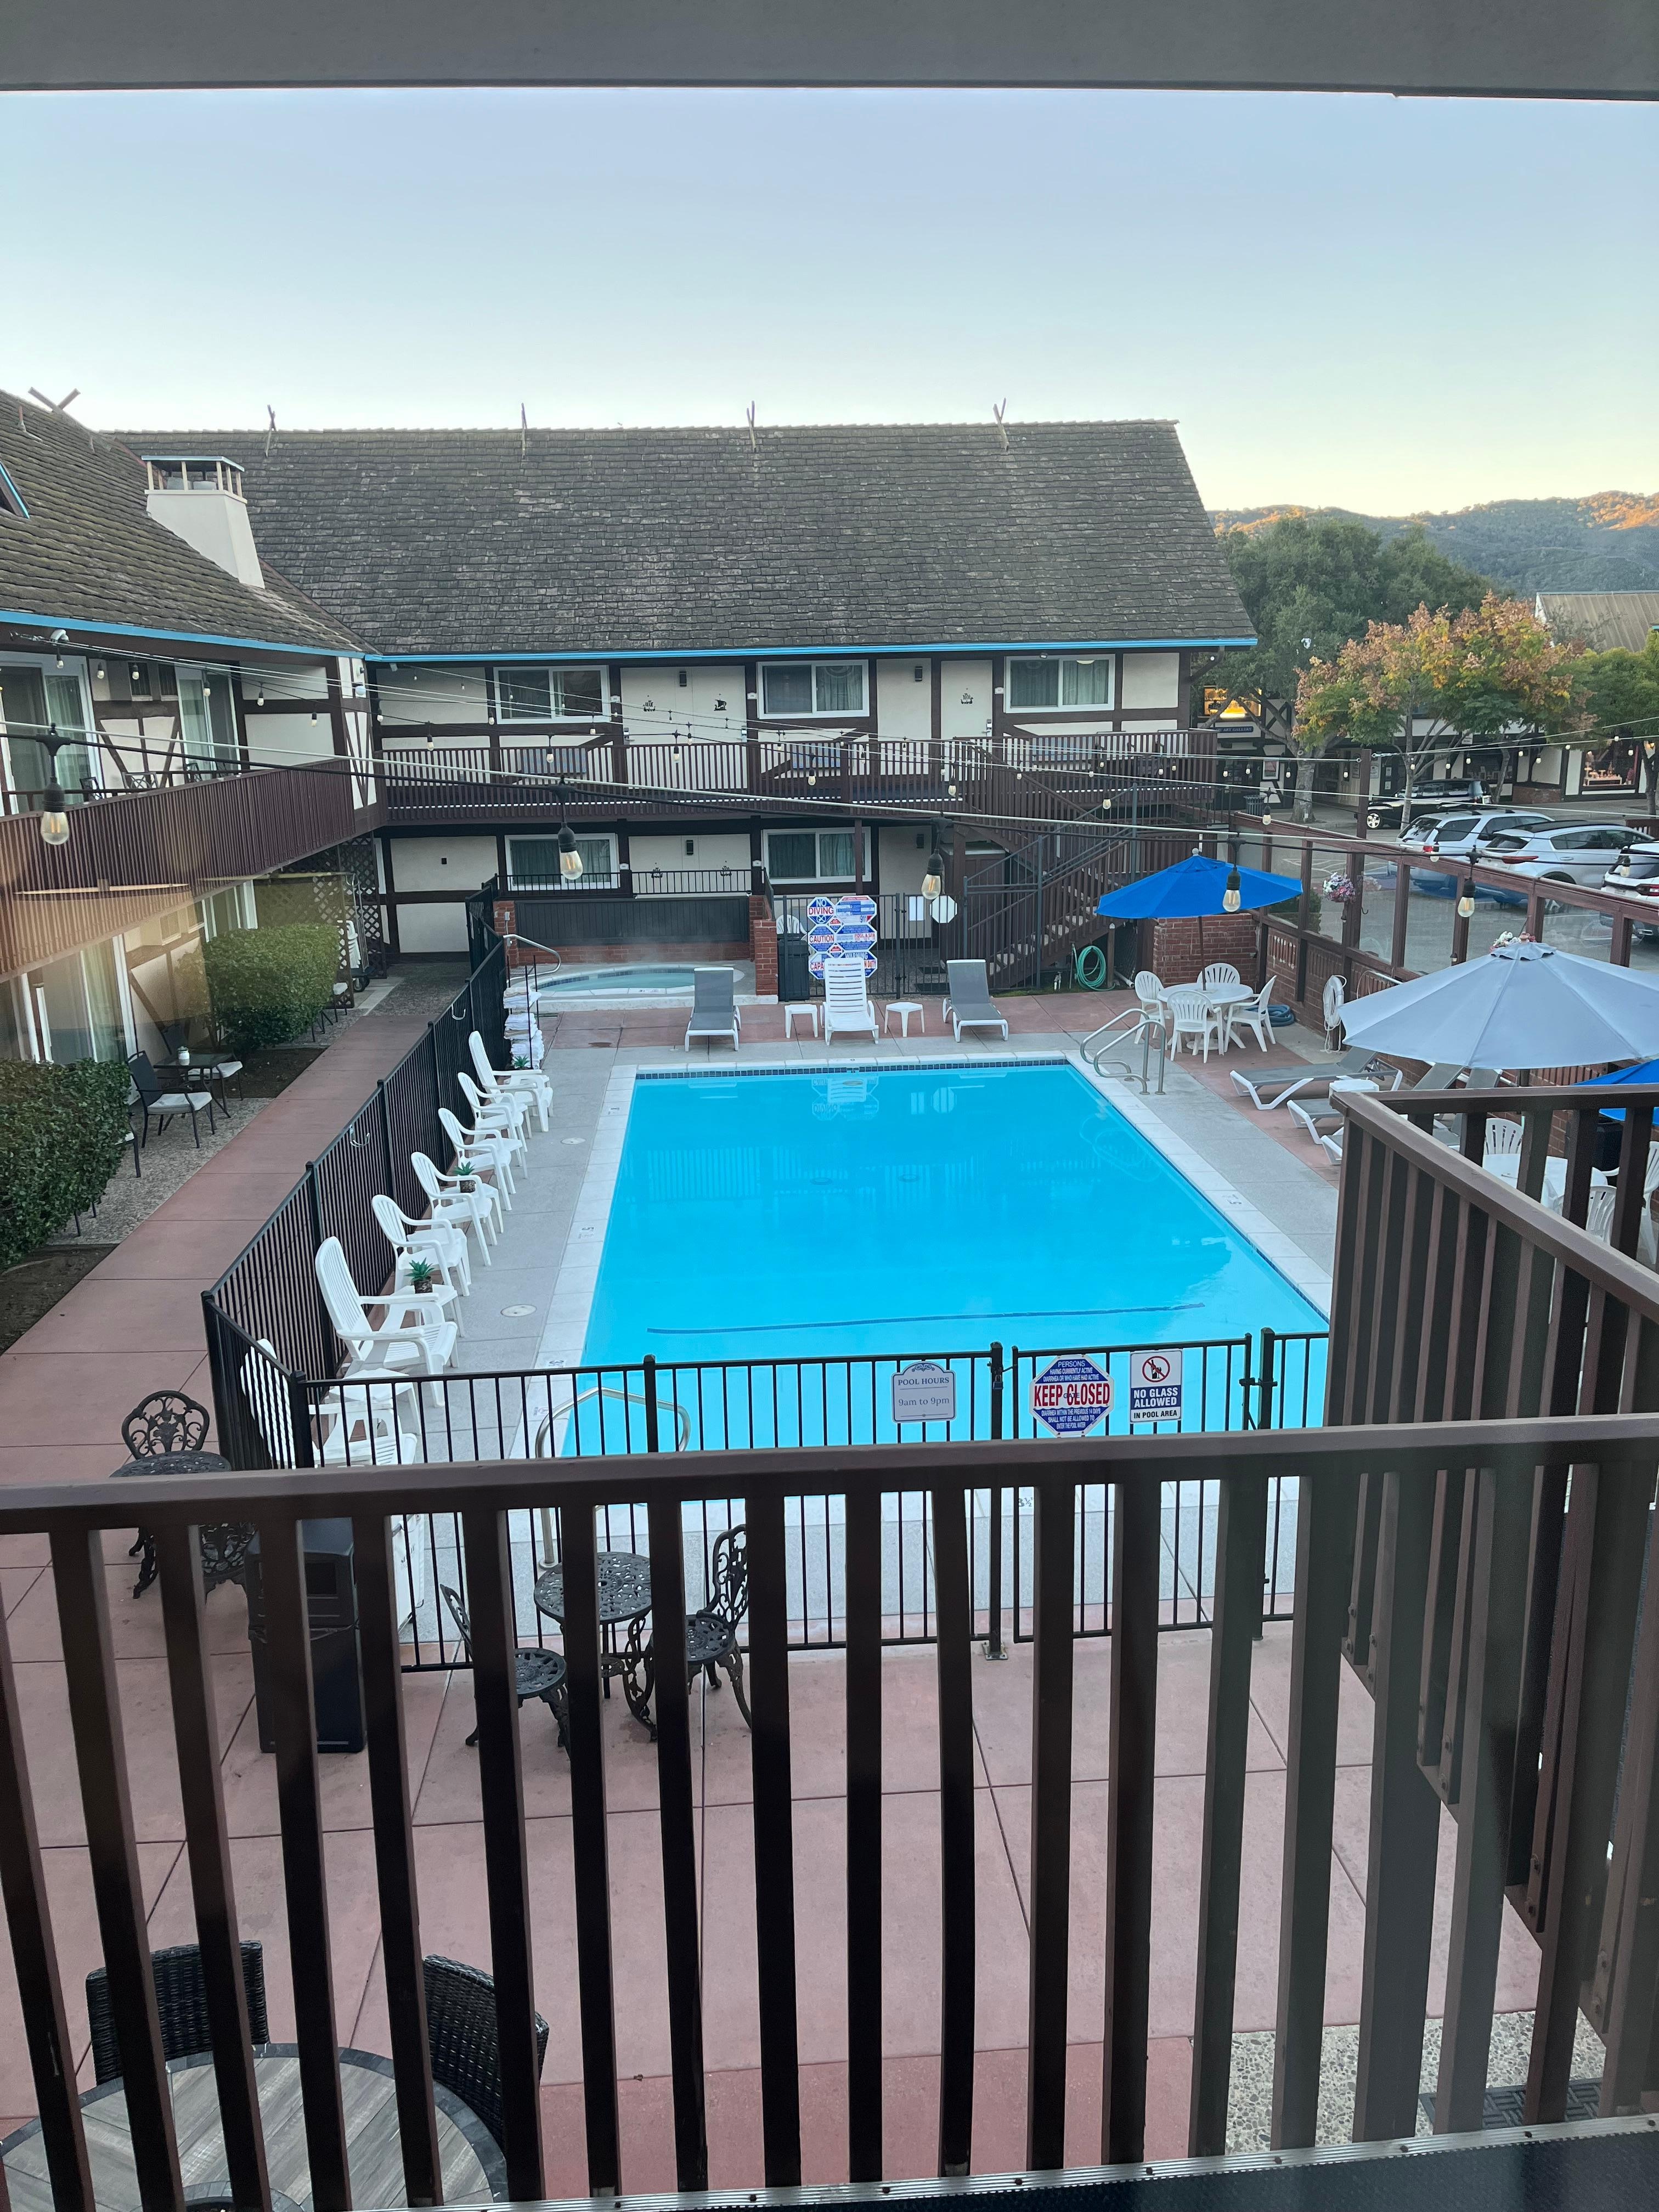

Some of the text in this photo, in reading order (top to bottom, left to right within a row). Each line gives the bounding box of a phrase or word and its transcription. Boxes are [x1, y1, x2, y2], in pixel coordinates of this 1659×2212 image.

[809, 935, 834, 943] CAUTION
[1034, 1383, 1110, 1407] KEEP CLOSED
[1133, 1387, 1178, 1398] NO GLASS
[931, 1397, 949, 1406] 9pm
[1134, 1397, 1177, 1408] ALLOWED
